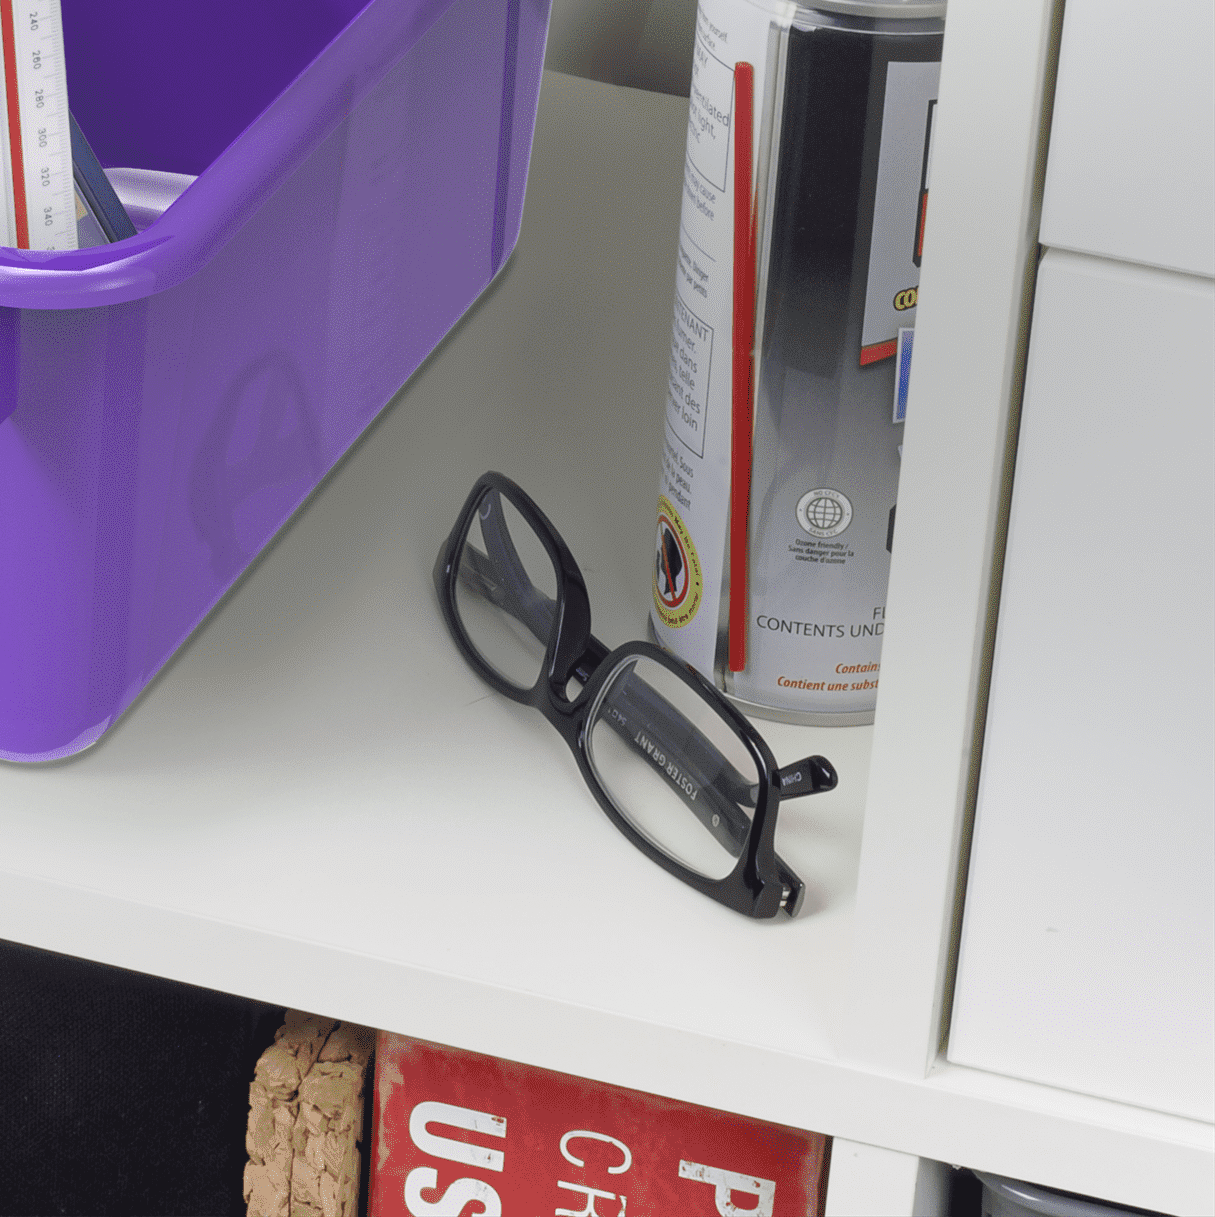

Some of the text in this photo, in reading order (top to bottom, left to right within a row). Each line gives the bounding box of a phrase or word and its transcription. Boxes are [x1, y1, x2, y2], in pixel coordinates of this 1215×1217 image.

[29, 11, 39, 31] 240
[32, 50, 42, 70] 260
[35, 88, 45, 109] 280
[37, 127, 47, 148] 300
[41, 167, 51, 188] 320
[43, 206, 53, 227] 340
[684, 393, 701, 415] des
[680, 408, 699, 433] loin
[788, 545, 804, 554] Sans
[805, 547, 830, 558] danger
[830, 550, 847, 558] pour
[794, 538, 817, 548] Ozone
[795, 555, 819, 563] couche
[756, 614, 845, 638] CONTENTS
[777, 675, 826, 692] Contient
[826, 682, 849, 692] une
[633, 730, 699, 802] FOSTER GRANT
